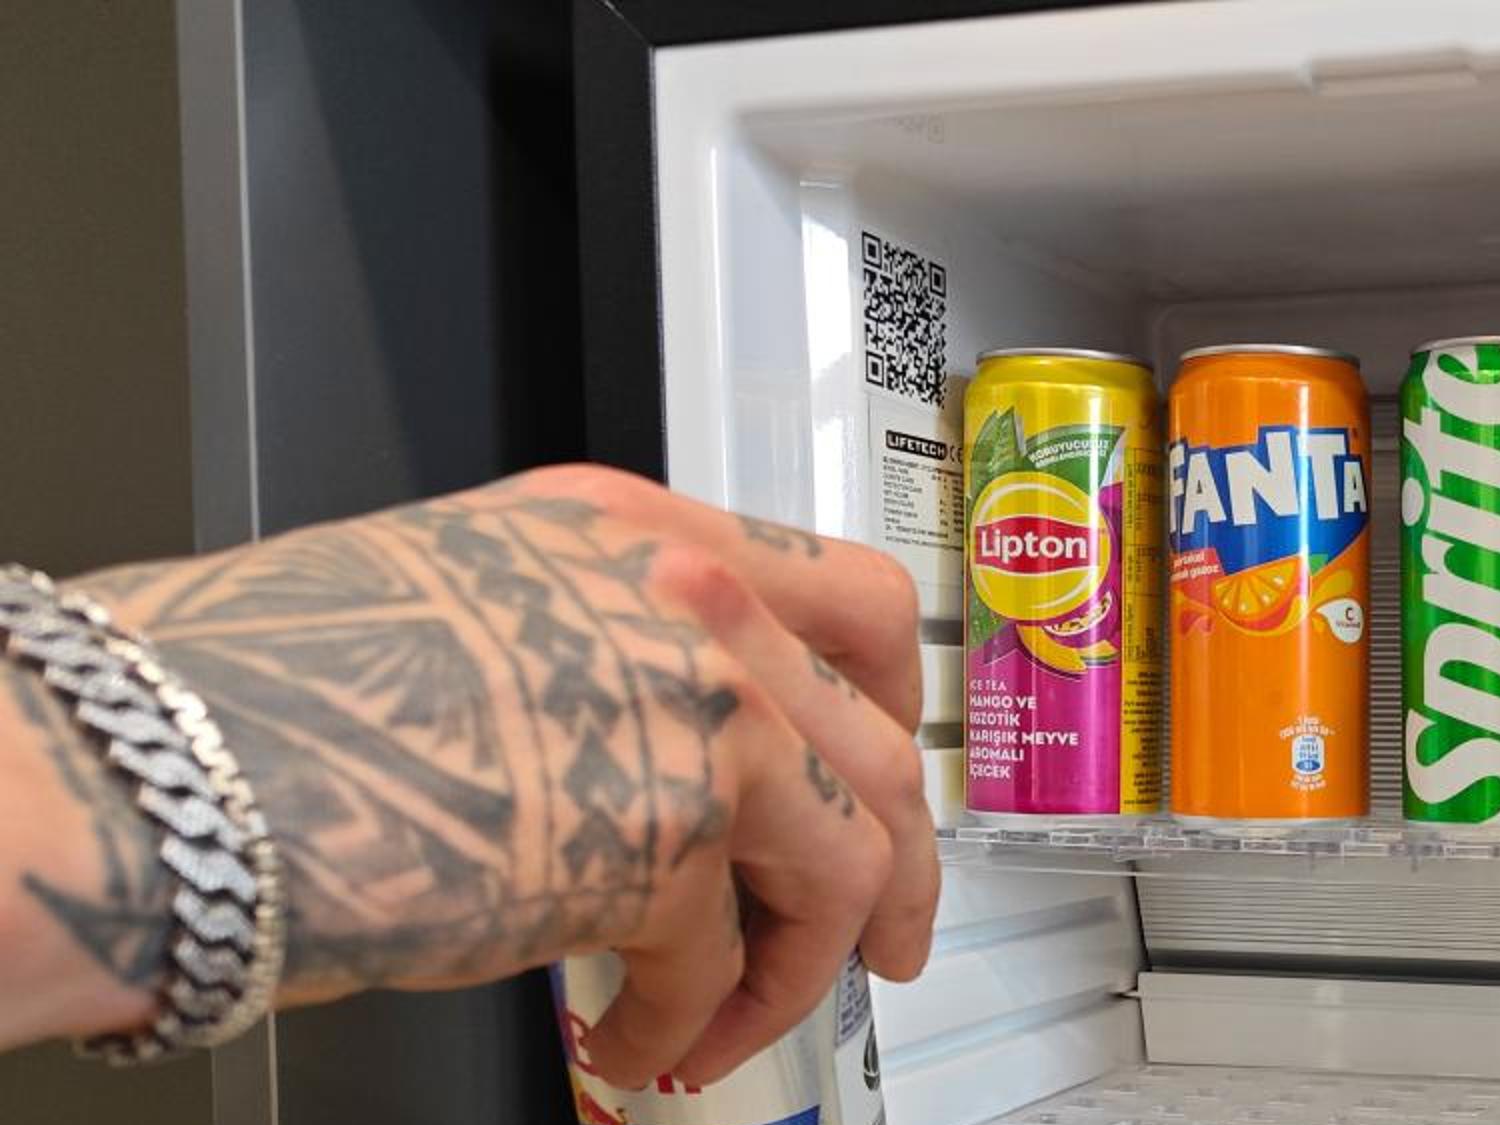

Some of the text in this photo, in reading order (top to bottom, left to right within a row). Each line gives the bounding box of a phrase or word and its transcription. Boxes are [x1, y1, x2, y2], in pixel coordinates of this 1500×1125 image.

[887, 434, 946, 457] LIFETECH
[981, 530, 1087, 564] Lipton
[969, 695, 1037, 710] MANGO VE
[969, 730, 1079, 746] KARIŞIK MEYVE
